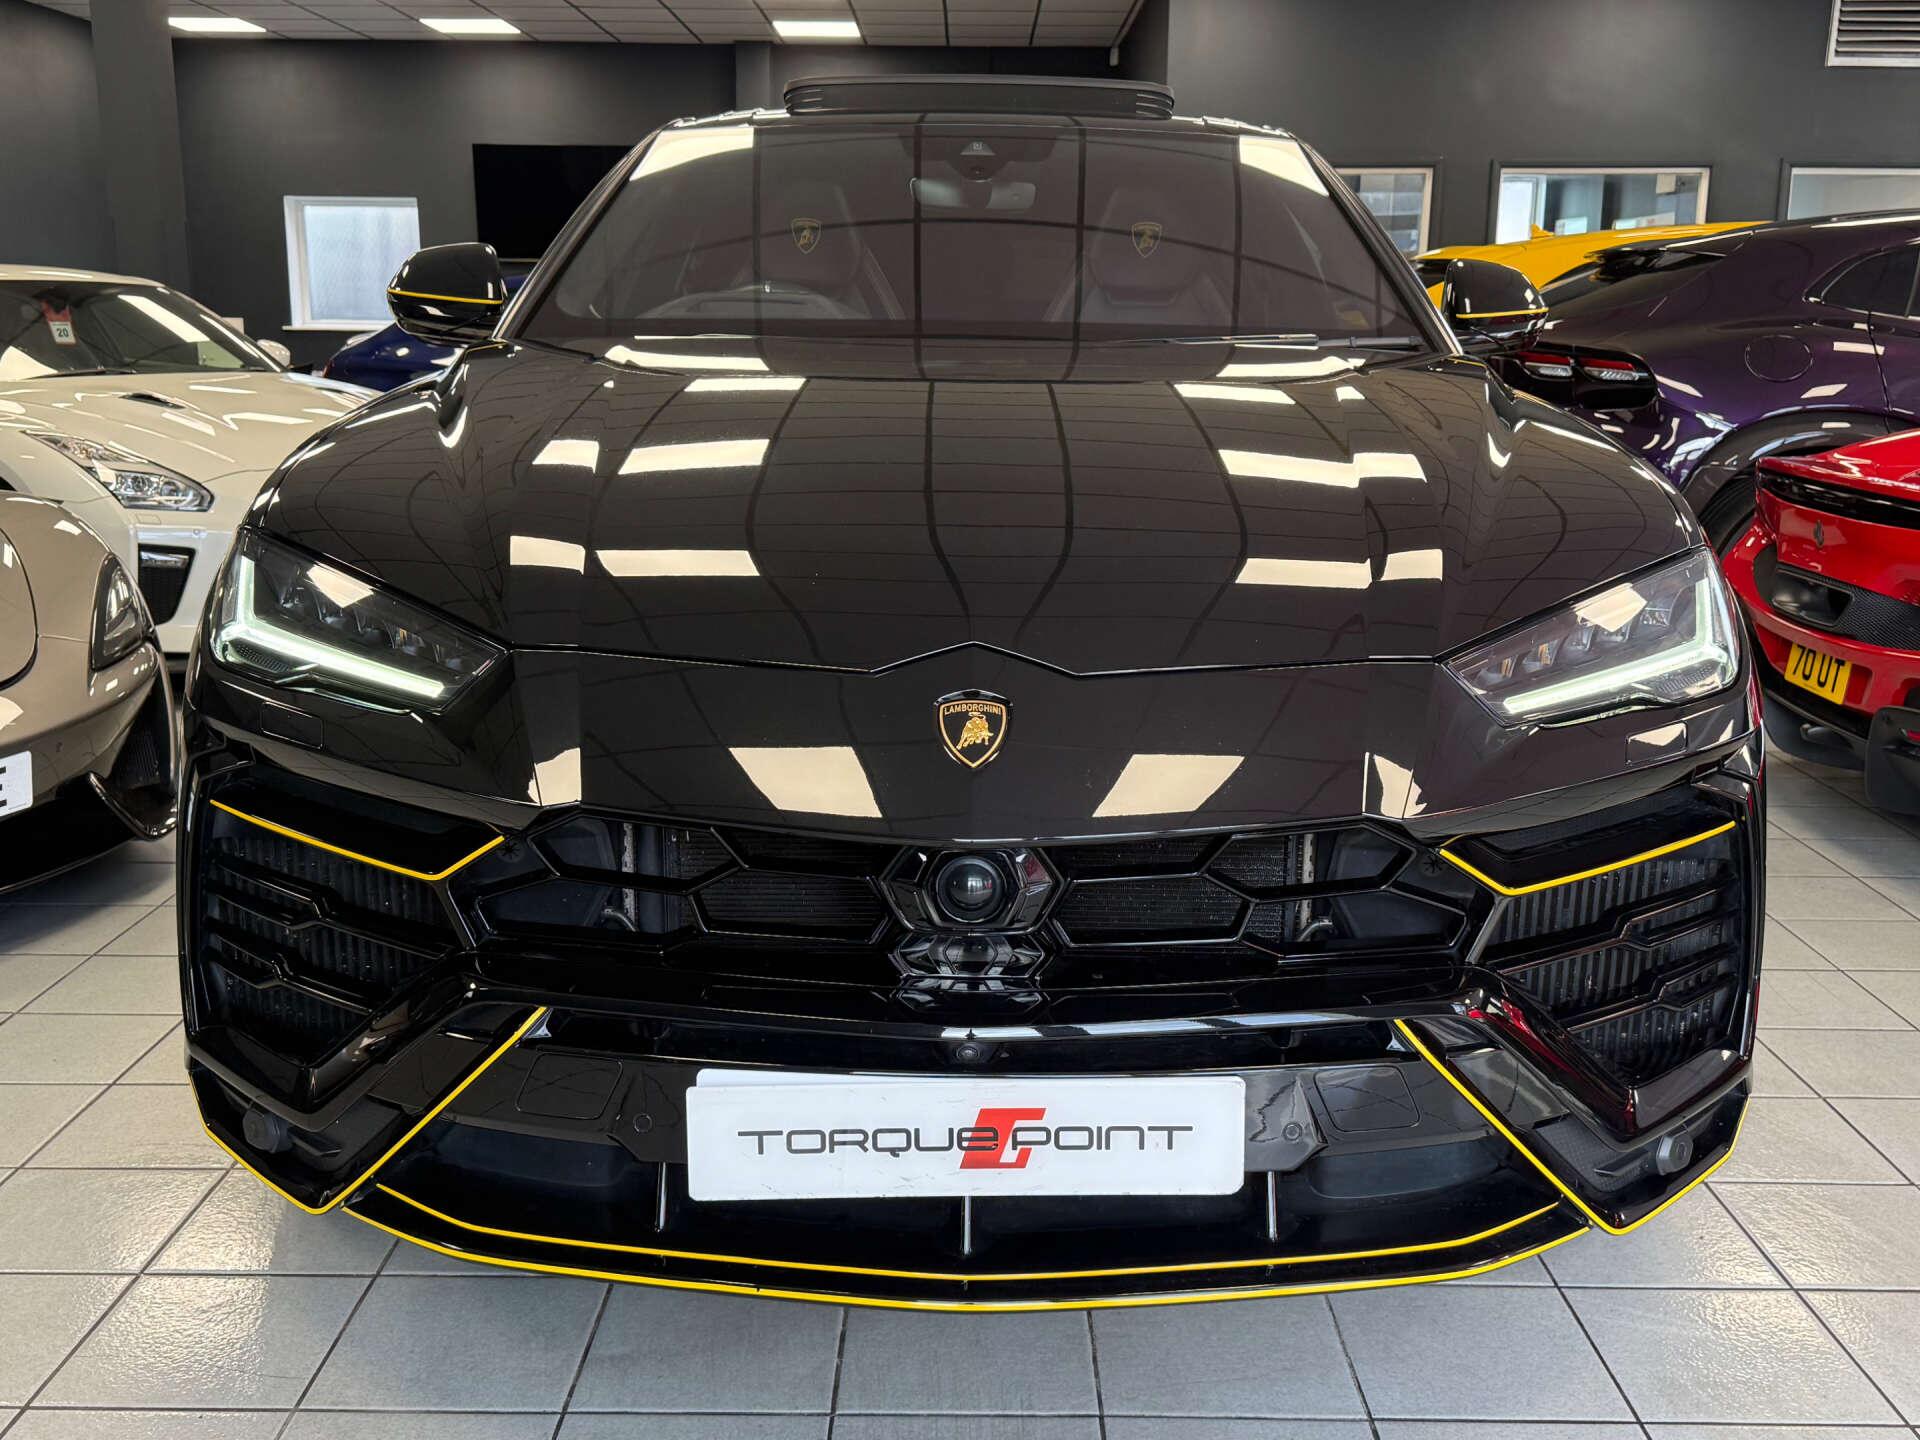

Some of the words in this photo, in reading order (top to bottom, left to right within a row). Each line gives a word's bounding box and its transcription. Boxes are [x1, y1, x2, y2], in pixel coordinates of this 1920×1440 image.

[944, 703, 1001, 715] LAMBORGHINI
[737, 1126, 999, 1158] TORQUE
[1011, 1125, 1194, 1151] POINT
